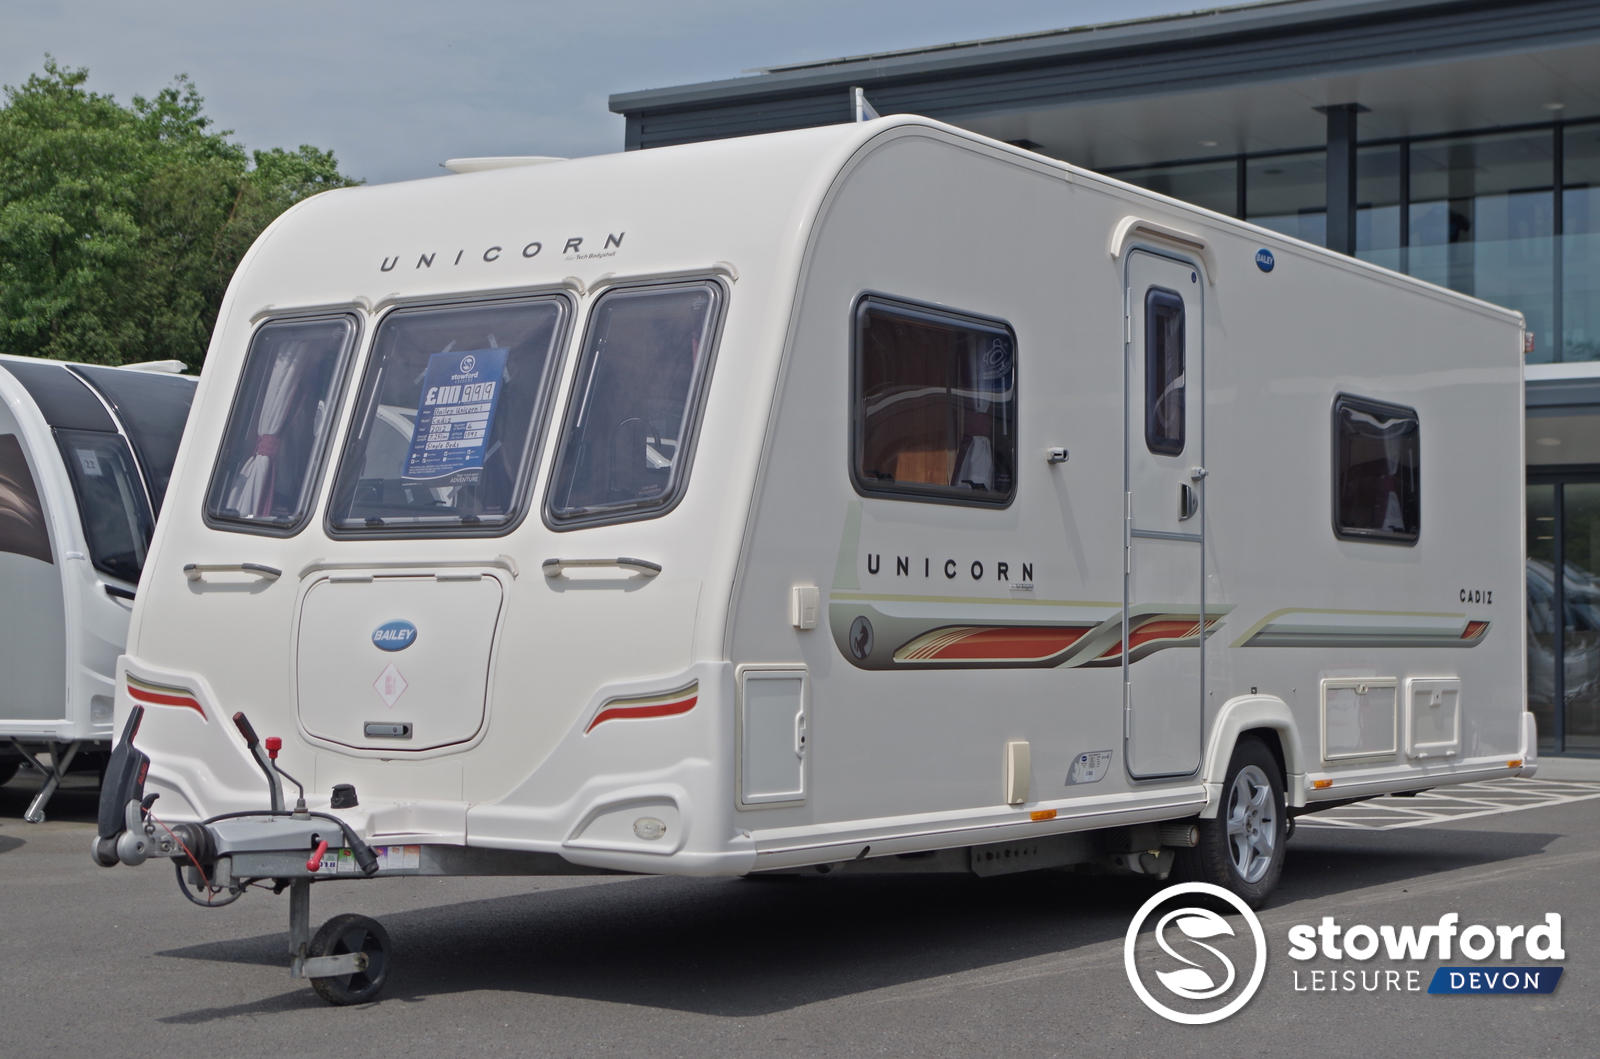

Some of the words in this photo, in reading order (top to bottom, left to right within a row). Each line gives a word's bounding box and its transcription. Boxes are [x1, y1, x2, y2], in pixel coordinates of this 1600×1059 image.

[380, 232, 625, 272] UNICORN
[451, 371, 479, 380] stowford
[868, 554, 1033, 581] UNICORN
[1460, 588, 1492, 604] CADIZ
[374, 629, 416, 641] BAILEY
